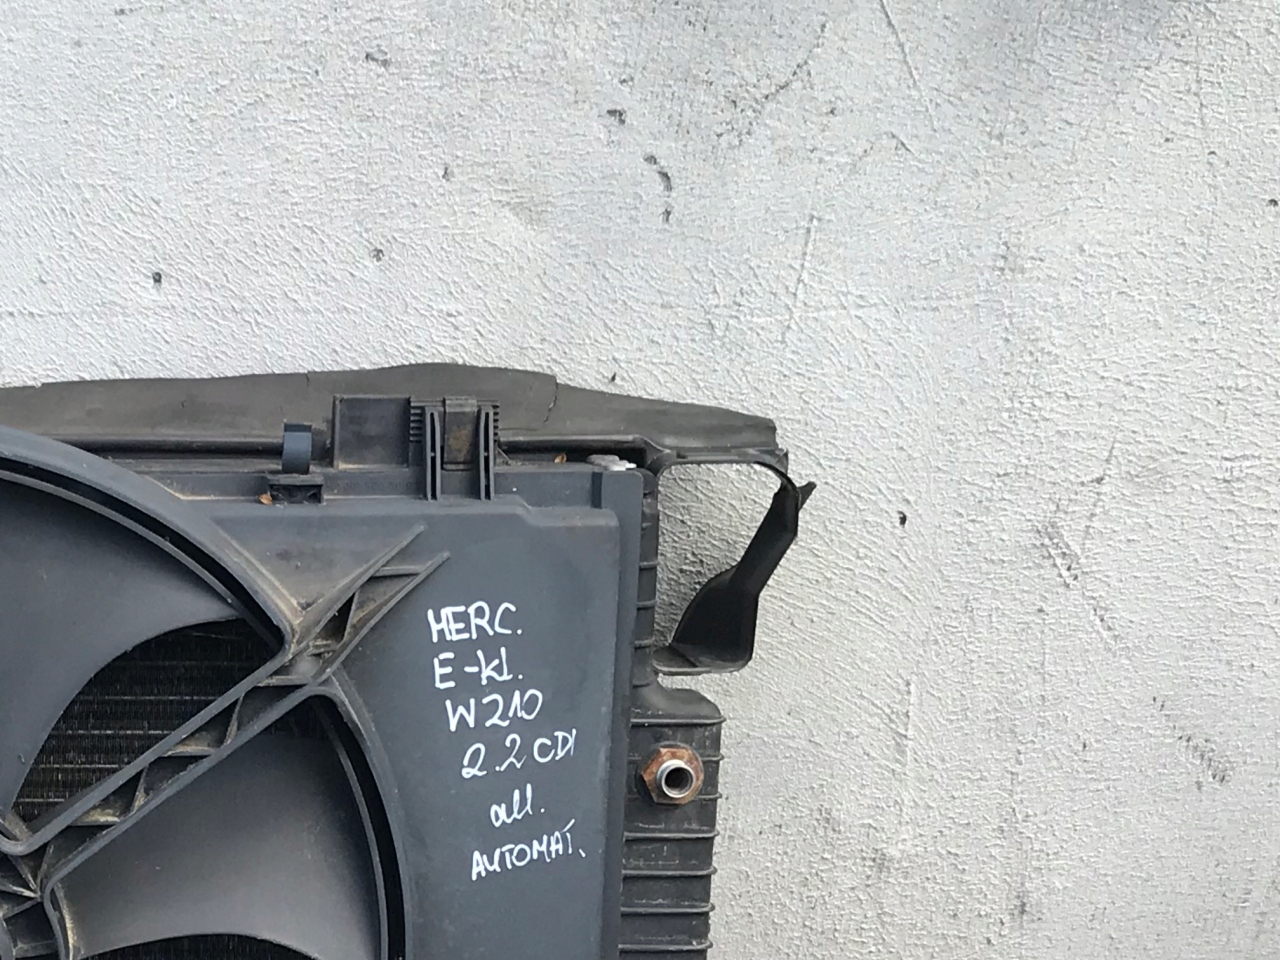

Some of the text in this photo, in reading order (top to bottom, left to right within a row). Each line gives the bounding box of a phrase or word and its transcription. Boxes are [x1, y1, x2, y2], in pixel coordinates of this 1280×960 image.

[427, 601, 522, 643] MERC.
[461, 728, 576, 779] 2.2 CDI
